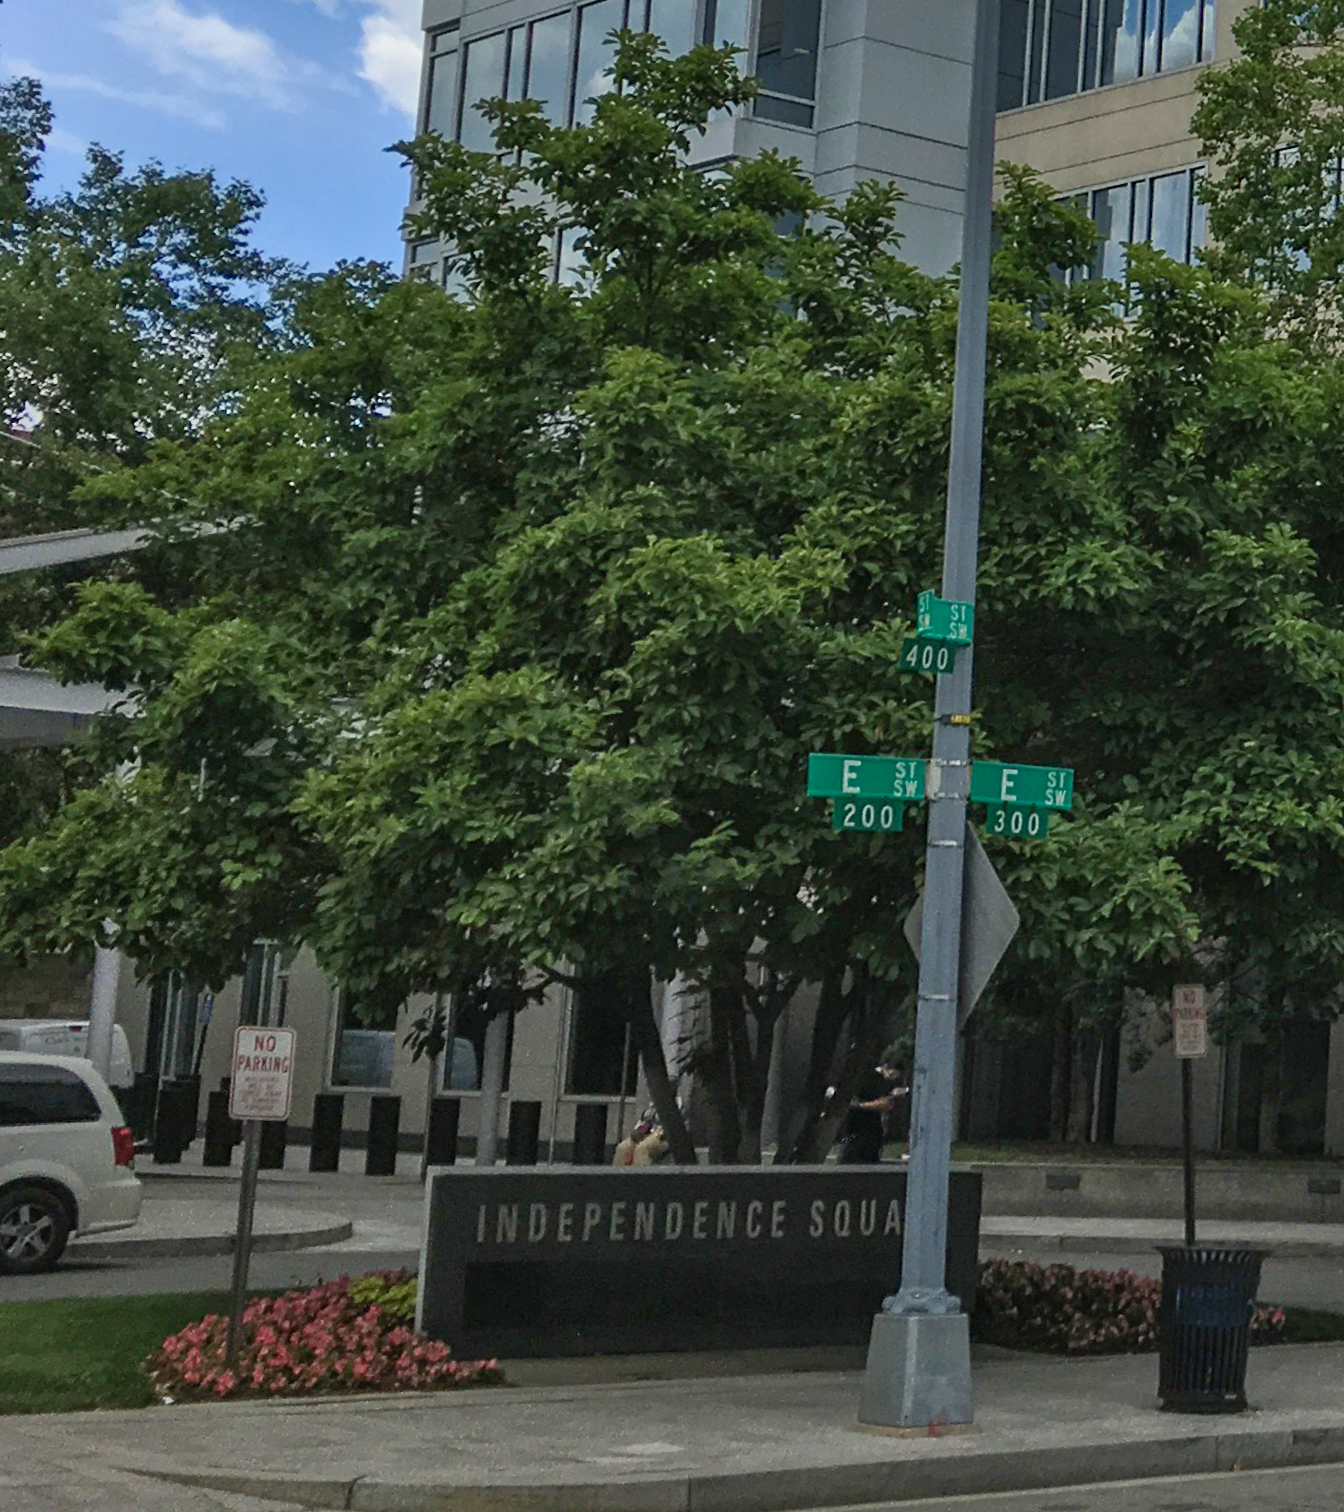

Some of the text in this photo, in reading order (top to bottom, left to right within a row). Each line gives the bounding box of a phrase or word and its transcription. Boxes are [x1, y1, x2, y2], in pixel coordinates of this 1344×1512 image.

[950, 604, 967, 621] ST
[949, 622, 968, 639] SW
[905, 643, 949, 670] 400
[842, 760, 917, 794] E ST
[893, 779, 918, 798] SW
[1001, 768, 1067, 802] E ST
[1045, 789, 1067, 806] SW
[843, 803, 893, 829] 200
[994, 809, 1040, 836] 300
[254, 1035, 277, 1052] NO
[237, 1053, 290, 1073] PARKING
[476, 1199, 903, 1243] INDEPENDENCE SQUA
